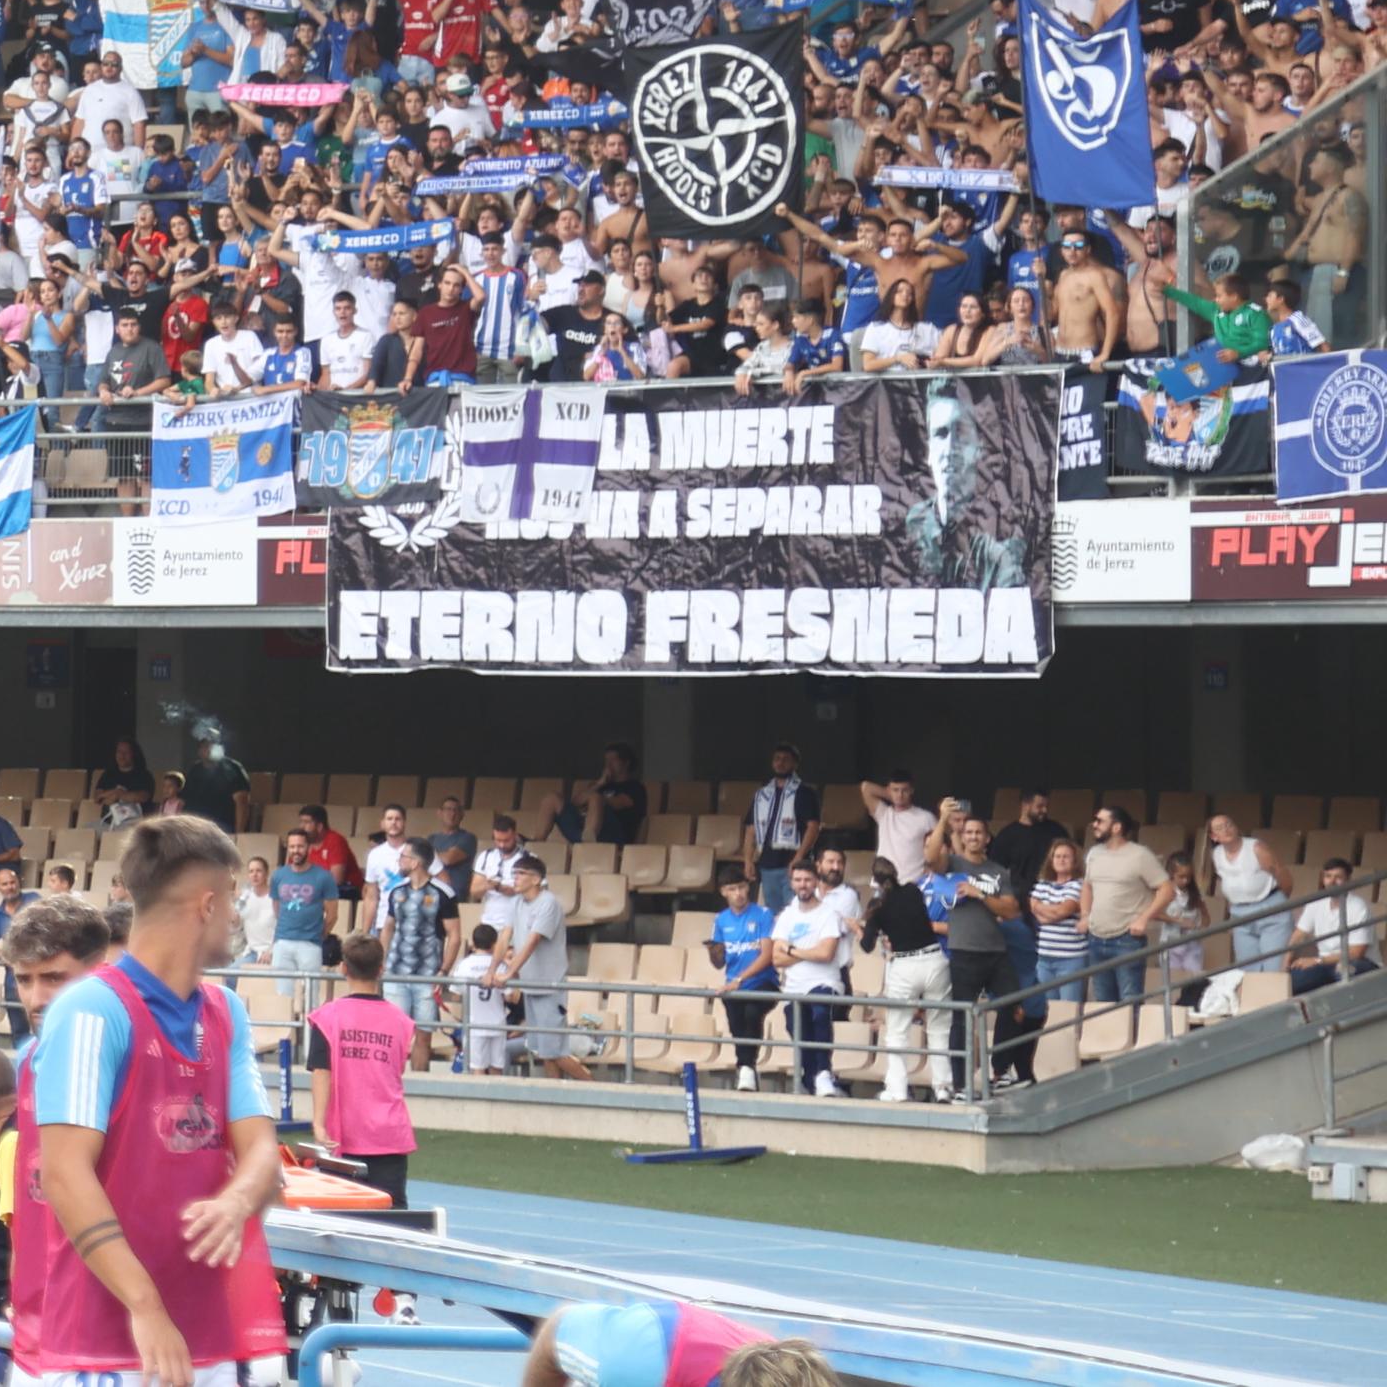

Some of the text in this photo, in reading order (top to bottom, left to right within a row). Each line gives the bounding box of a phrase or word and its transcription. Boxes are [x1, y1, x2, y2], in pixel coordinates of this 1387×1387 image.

[642, 60, 778, 131] XEREZ 1947
[655, 143, 783, 212] HOOLS XCD
[161, 399, 291, 430] SHERRY FAMILY
[555, 401, 591, 421] XCD
[598, 405, 835, 471] LA MUERTE
[304, 426, 438, 487] 19 47
[157, 499, 191, 517] XCD
[541, 488, 584, 509] 1947
[648, 484, 883, 539] A SEPARAR
[162, 550, 244, 562] Ayuntamiento
[1086, 539, 1175, 554] Ayuntamiento
[1211, 524, 1331, 567] PLAY
[1, 540, 22, 589] SIN
[59, 561, 107, 593] Xerez
[162, 565, 208, 578] de Jerez
[1086, 556, 1135, 572] de Jerez
[338, 587, 1039, 664] ETERNO FRESNEDA
[340, 1029, 393, 1048] ASISTENTE
[341, 1046, 391, 1064] XEREZ C.D.
